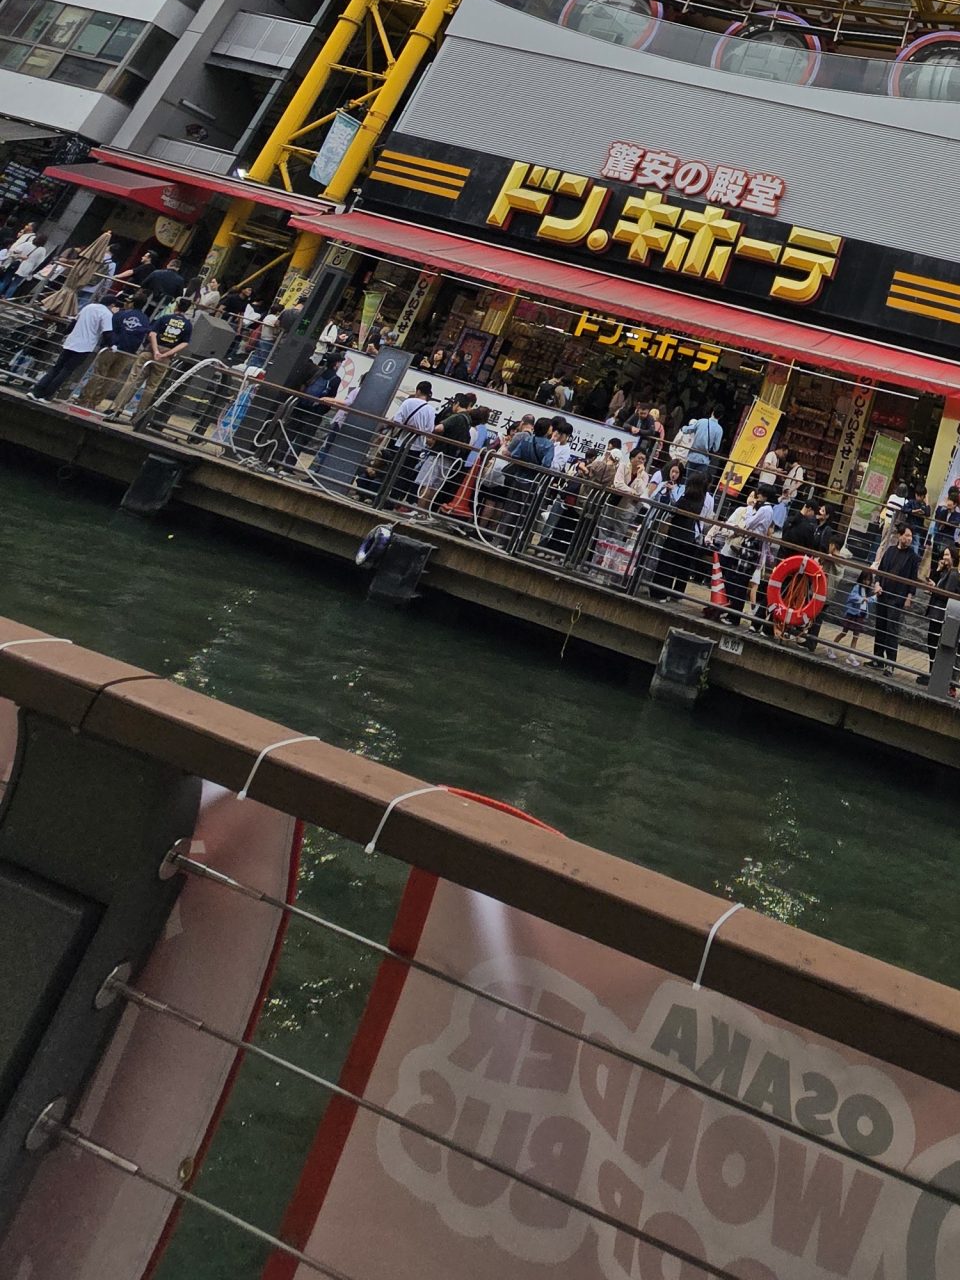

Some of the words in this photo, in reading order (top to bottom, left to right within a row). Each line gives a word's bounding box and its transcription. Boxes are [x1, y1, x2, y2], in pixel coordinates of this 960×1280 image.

[601, 140, 787, 217] 驚安の殿堂
